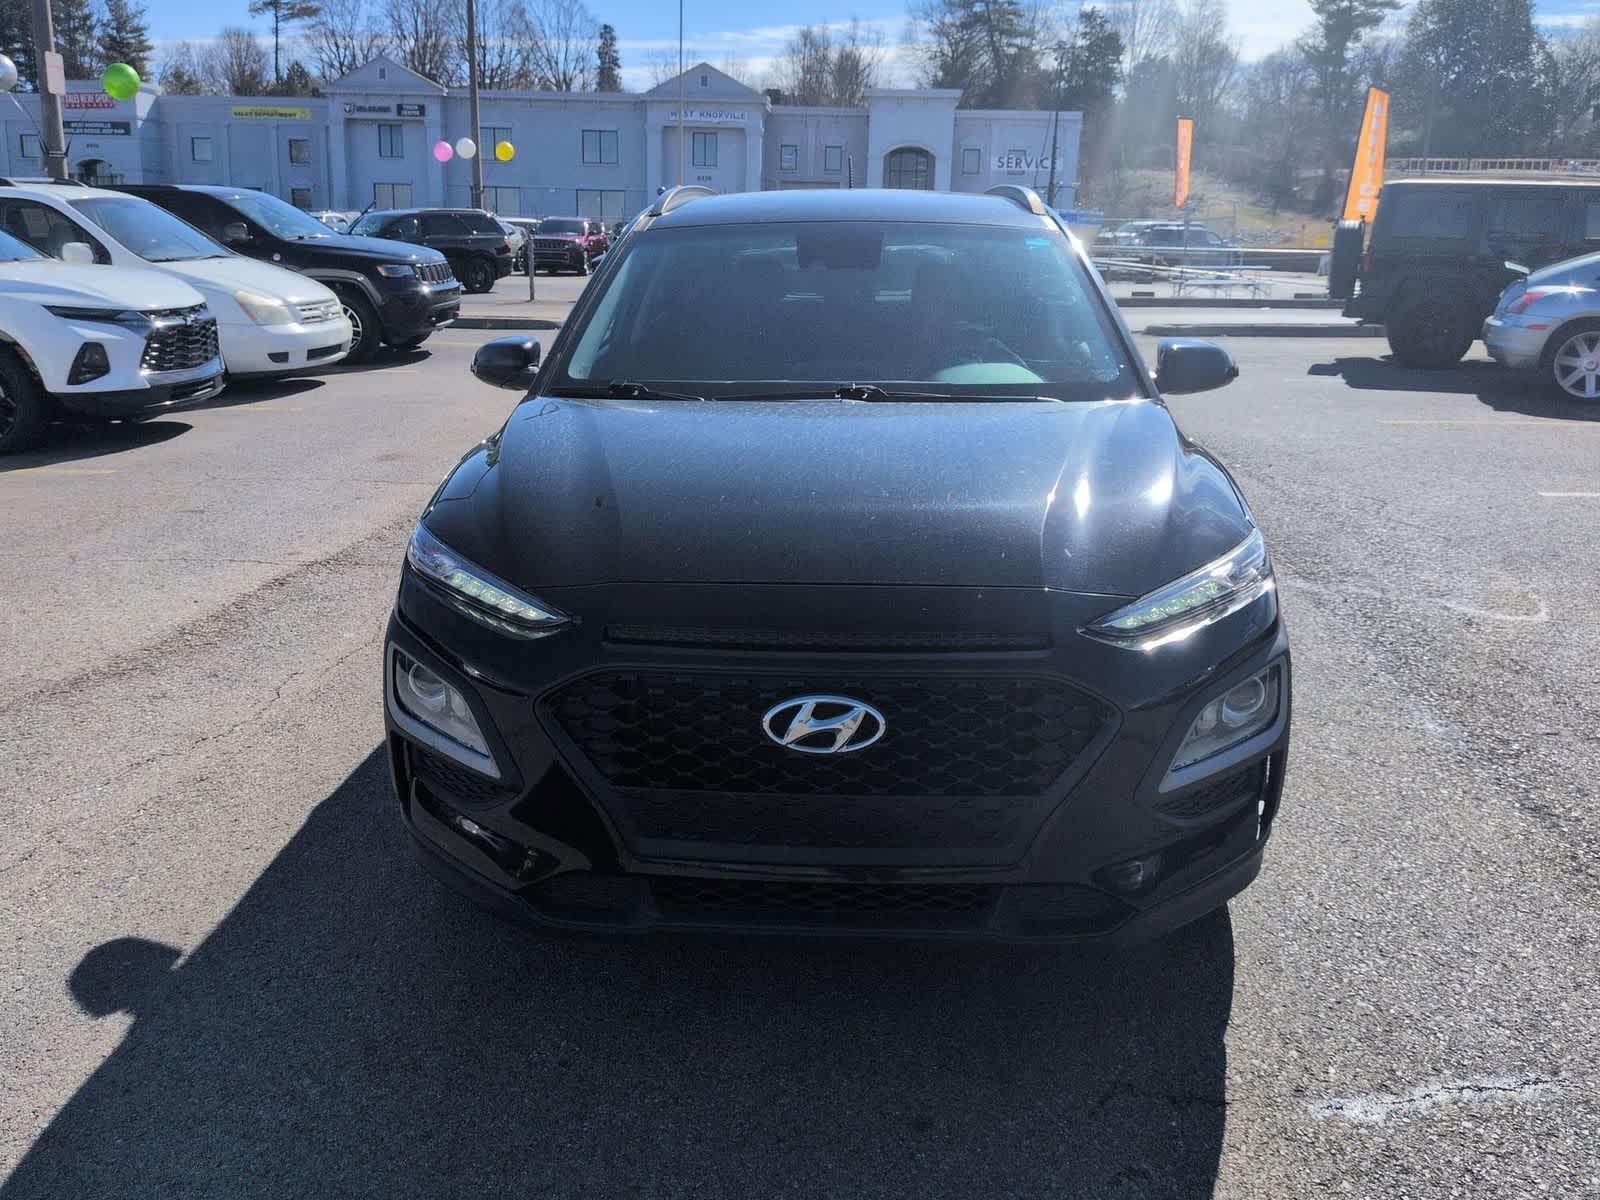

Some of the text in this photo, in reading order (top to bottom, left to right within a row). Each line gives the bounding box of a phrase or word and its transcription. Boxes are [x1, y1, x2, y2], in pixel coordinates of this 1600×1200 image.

[670, 111, 745, 120] WST KNOXVILLE
[997, 156, 1056, 169] SERVIC
